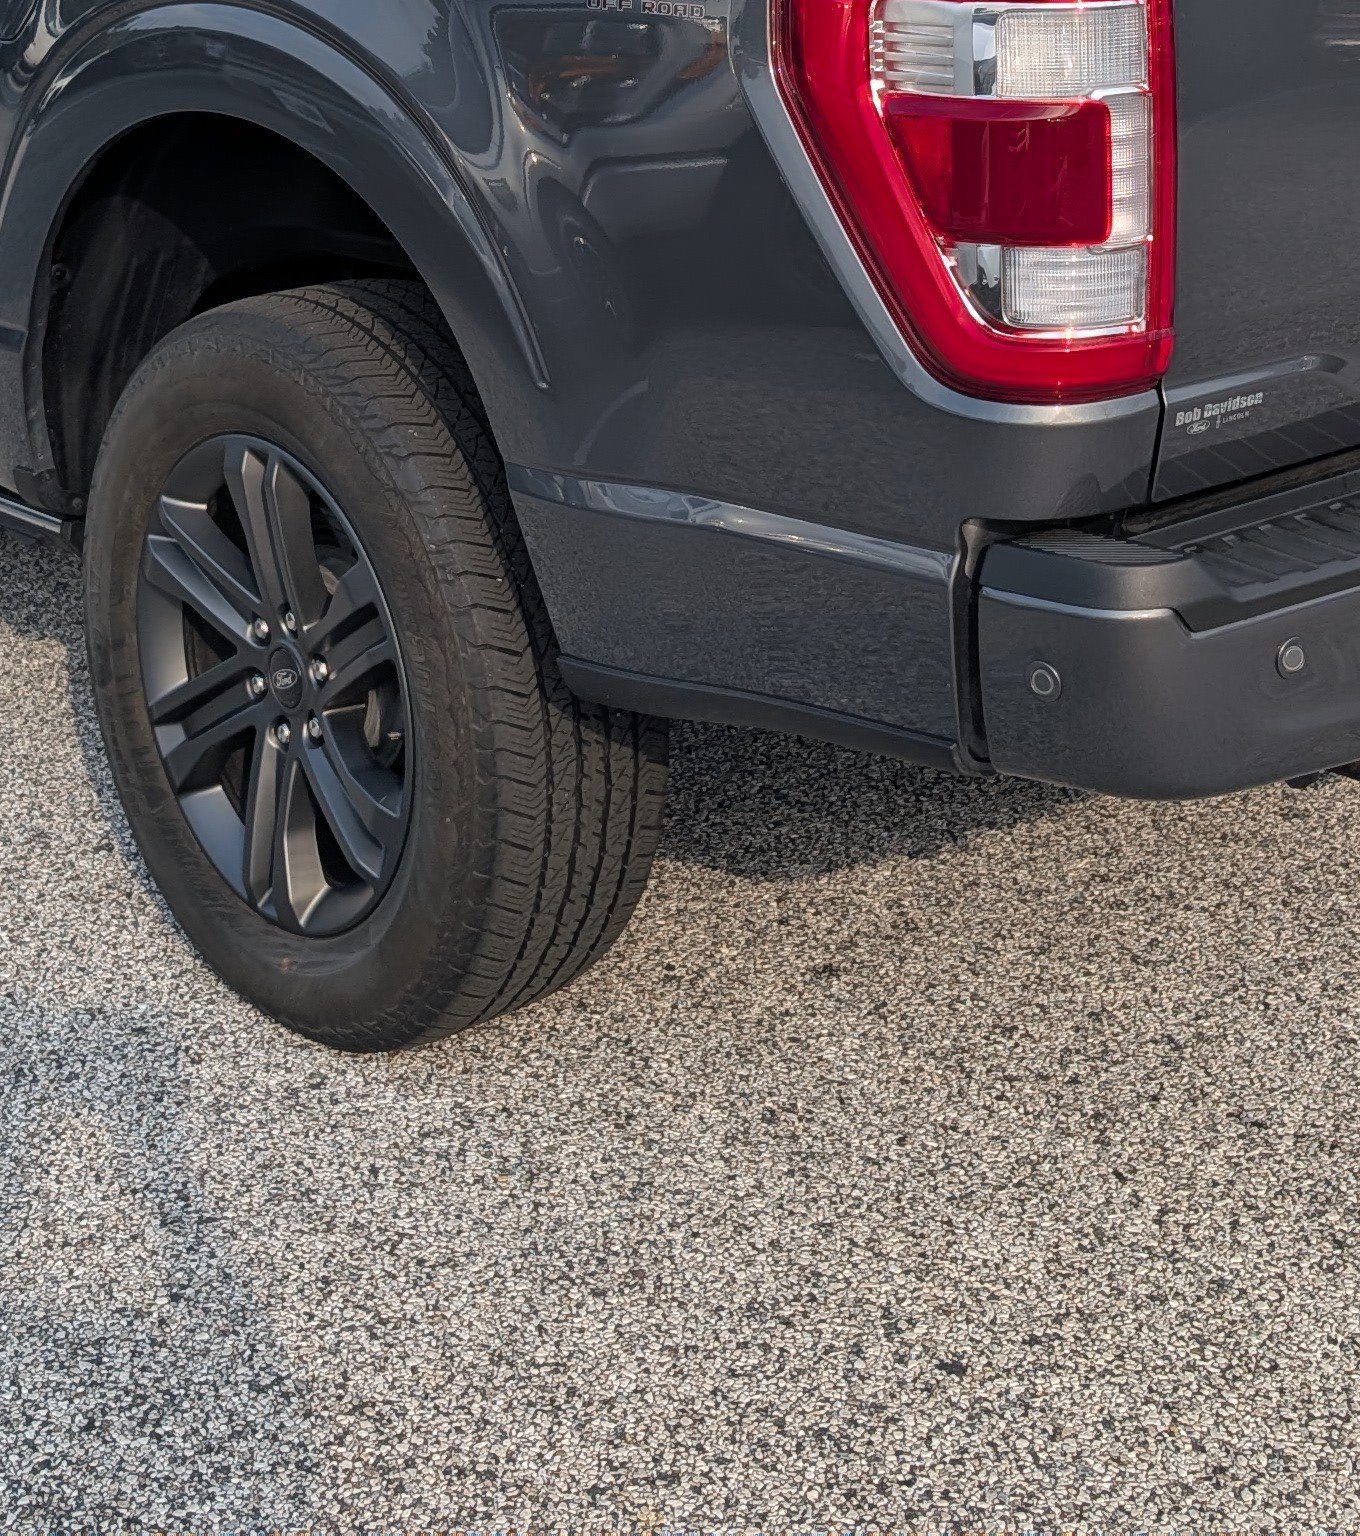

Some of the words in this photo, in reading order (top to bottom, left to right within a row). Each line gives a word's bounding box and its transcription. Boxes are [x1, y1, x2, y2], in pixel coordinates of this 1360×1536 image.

[640, 0, 706, 19] ROAD
[1175, 407, 1202, 427] Bob
[1203, 391, 1264, 419] Davidson
